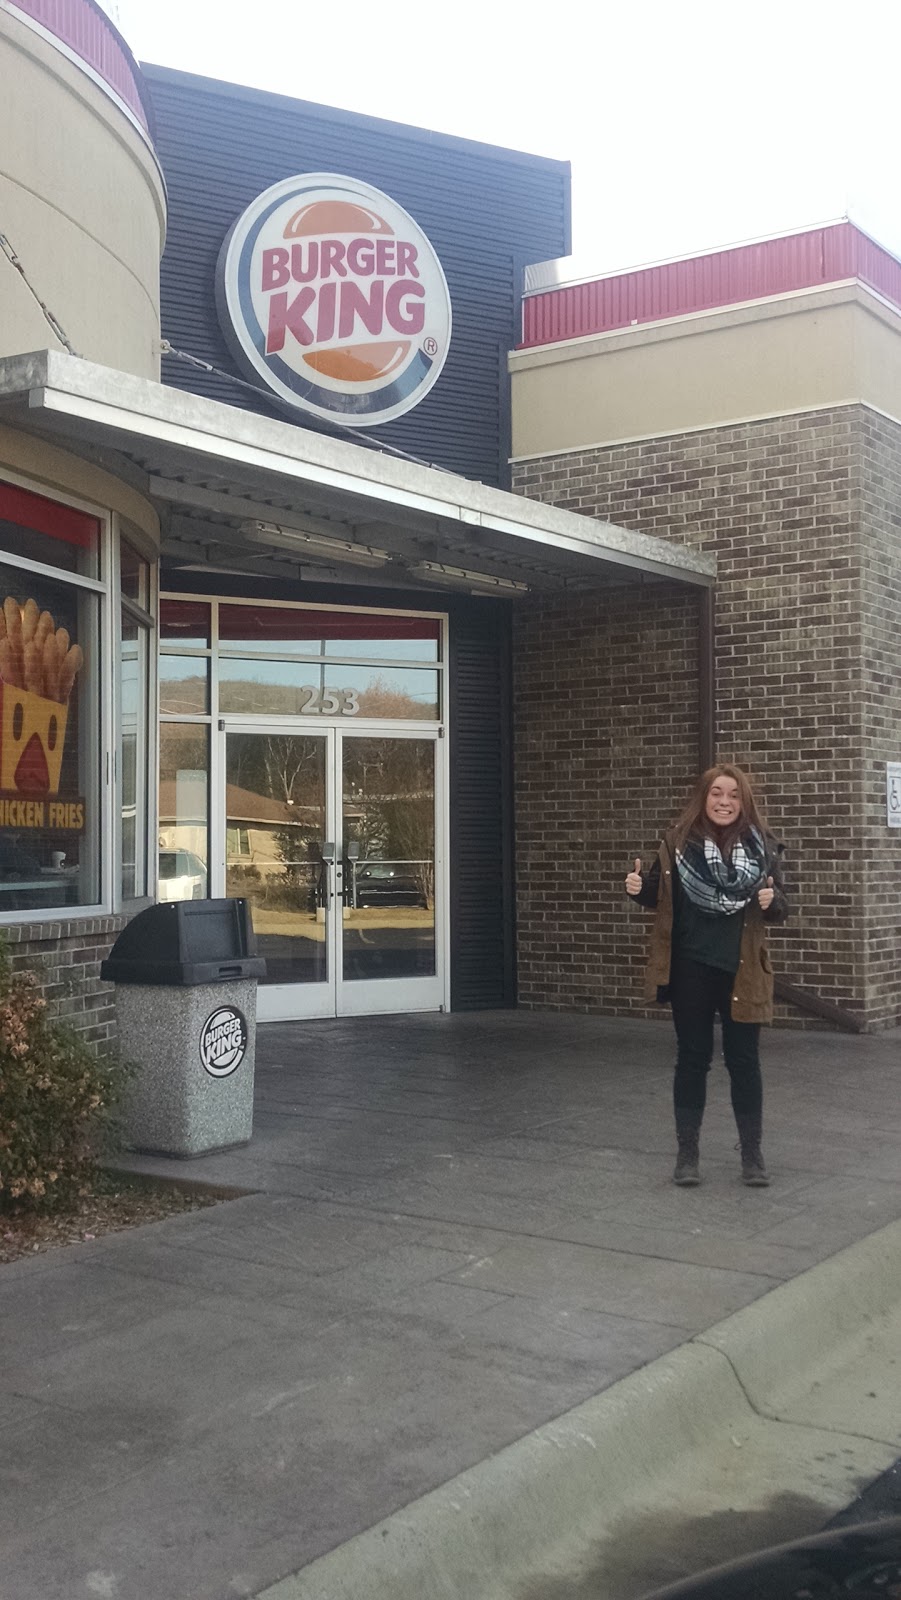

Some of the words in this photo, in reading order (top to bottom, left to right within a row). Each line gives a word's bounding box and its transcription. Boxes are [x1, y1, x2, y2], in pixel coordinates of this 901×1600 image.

[262, 238, 420, 292] BURGER
[267, 279, 426, 354] KING
[301, 685, 360, 716] 253
[49, 802, 84, 829] FRIES
[205, 1018, 241, 1048] BURGER
[206, 1030, 242, 1065] KING
